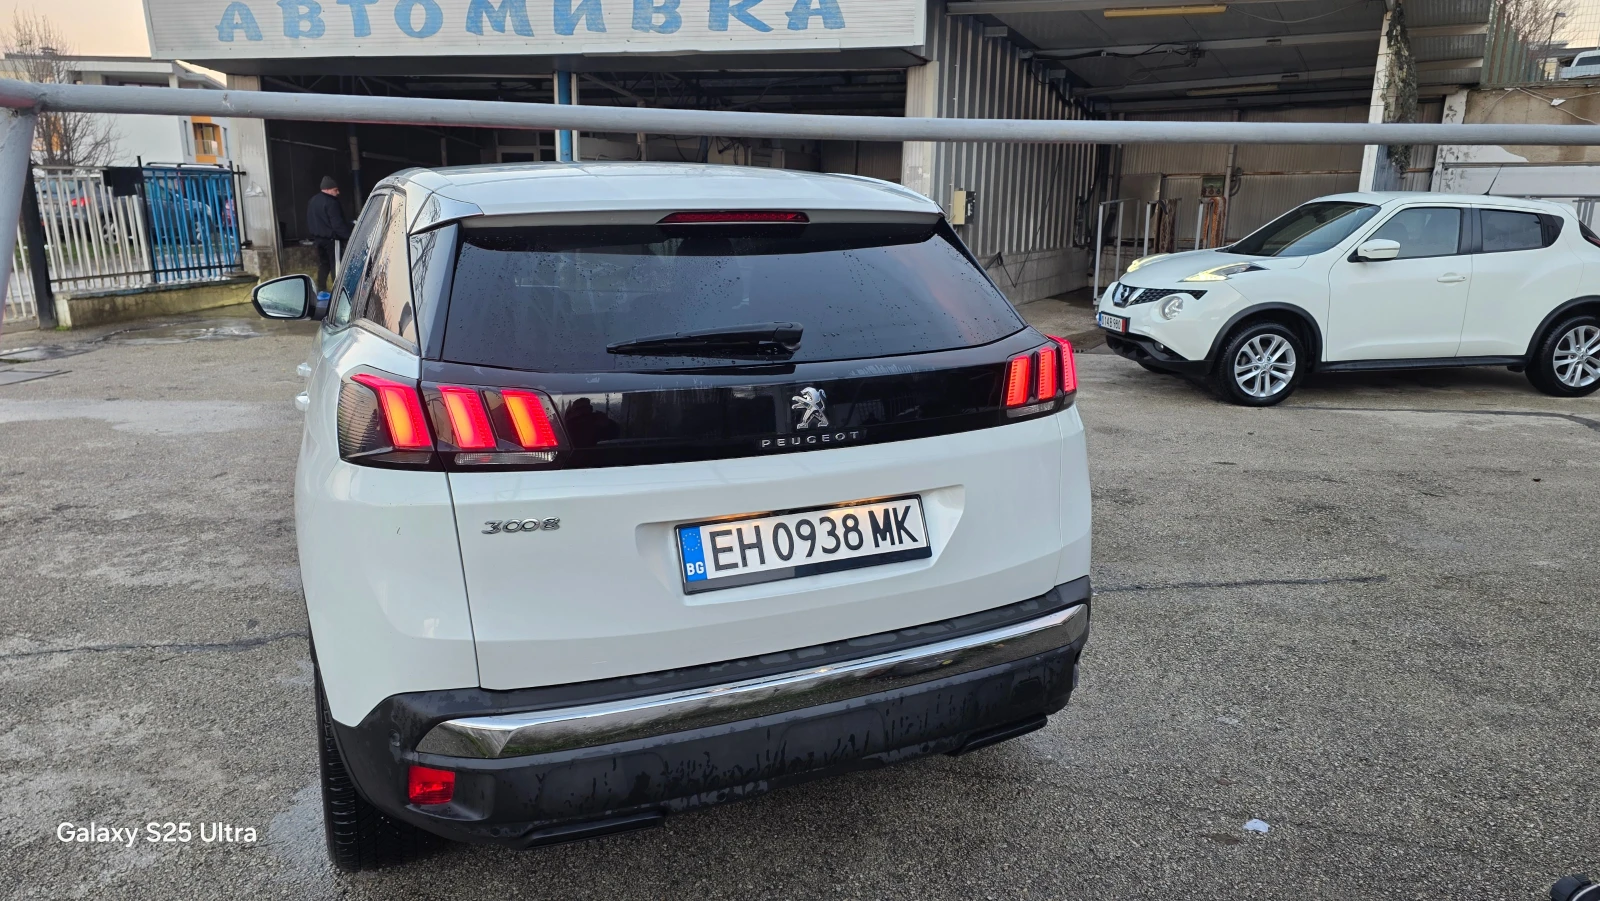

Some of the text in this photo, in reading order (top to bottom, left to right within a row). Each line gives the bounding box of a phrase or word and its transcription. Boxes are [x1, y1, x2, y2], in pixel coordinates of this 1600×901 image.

[215, 0, 846, 42] АВТОМИВКА
[761, 431, 859, 448] PEUGEOT
[481, 516, 561, 534] 3008
[709, 505, 919, 571] EH 0938 MK
[686, 562, 705, 576] BG
